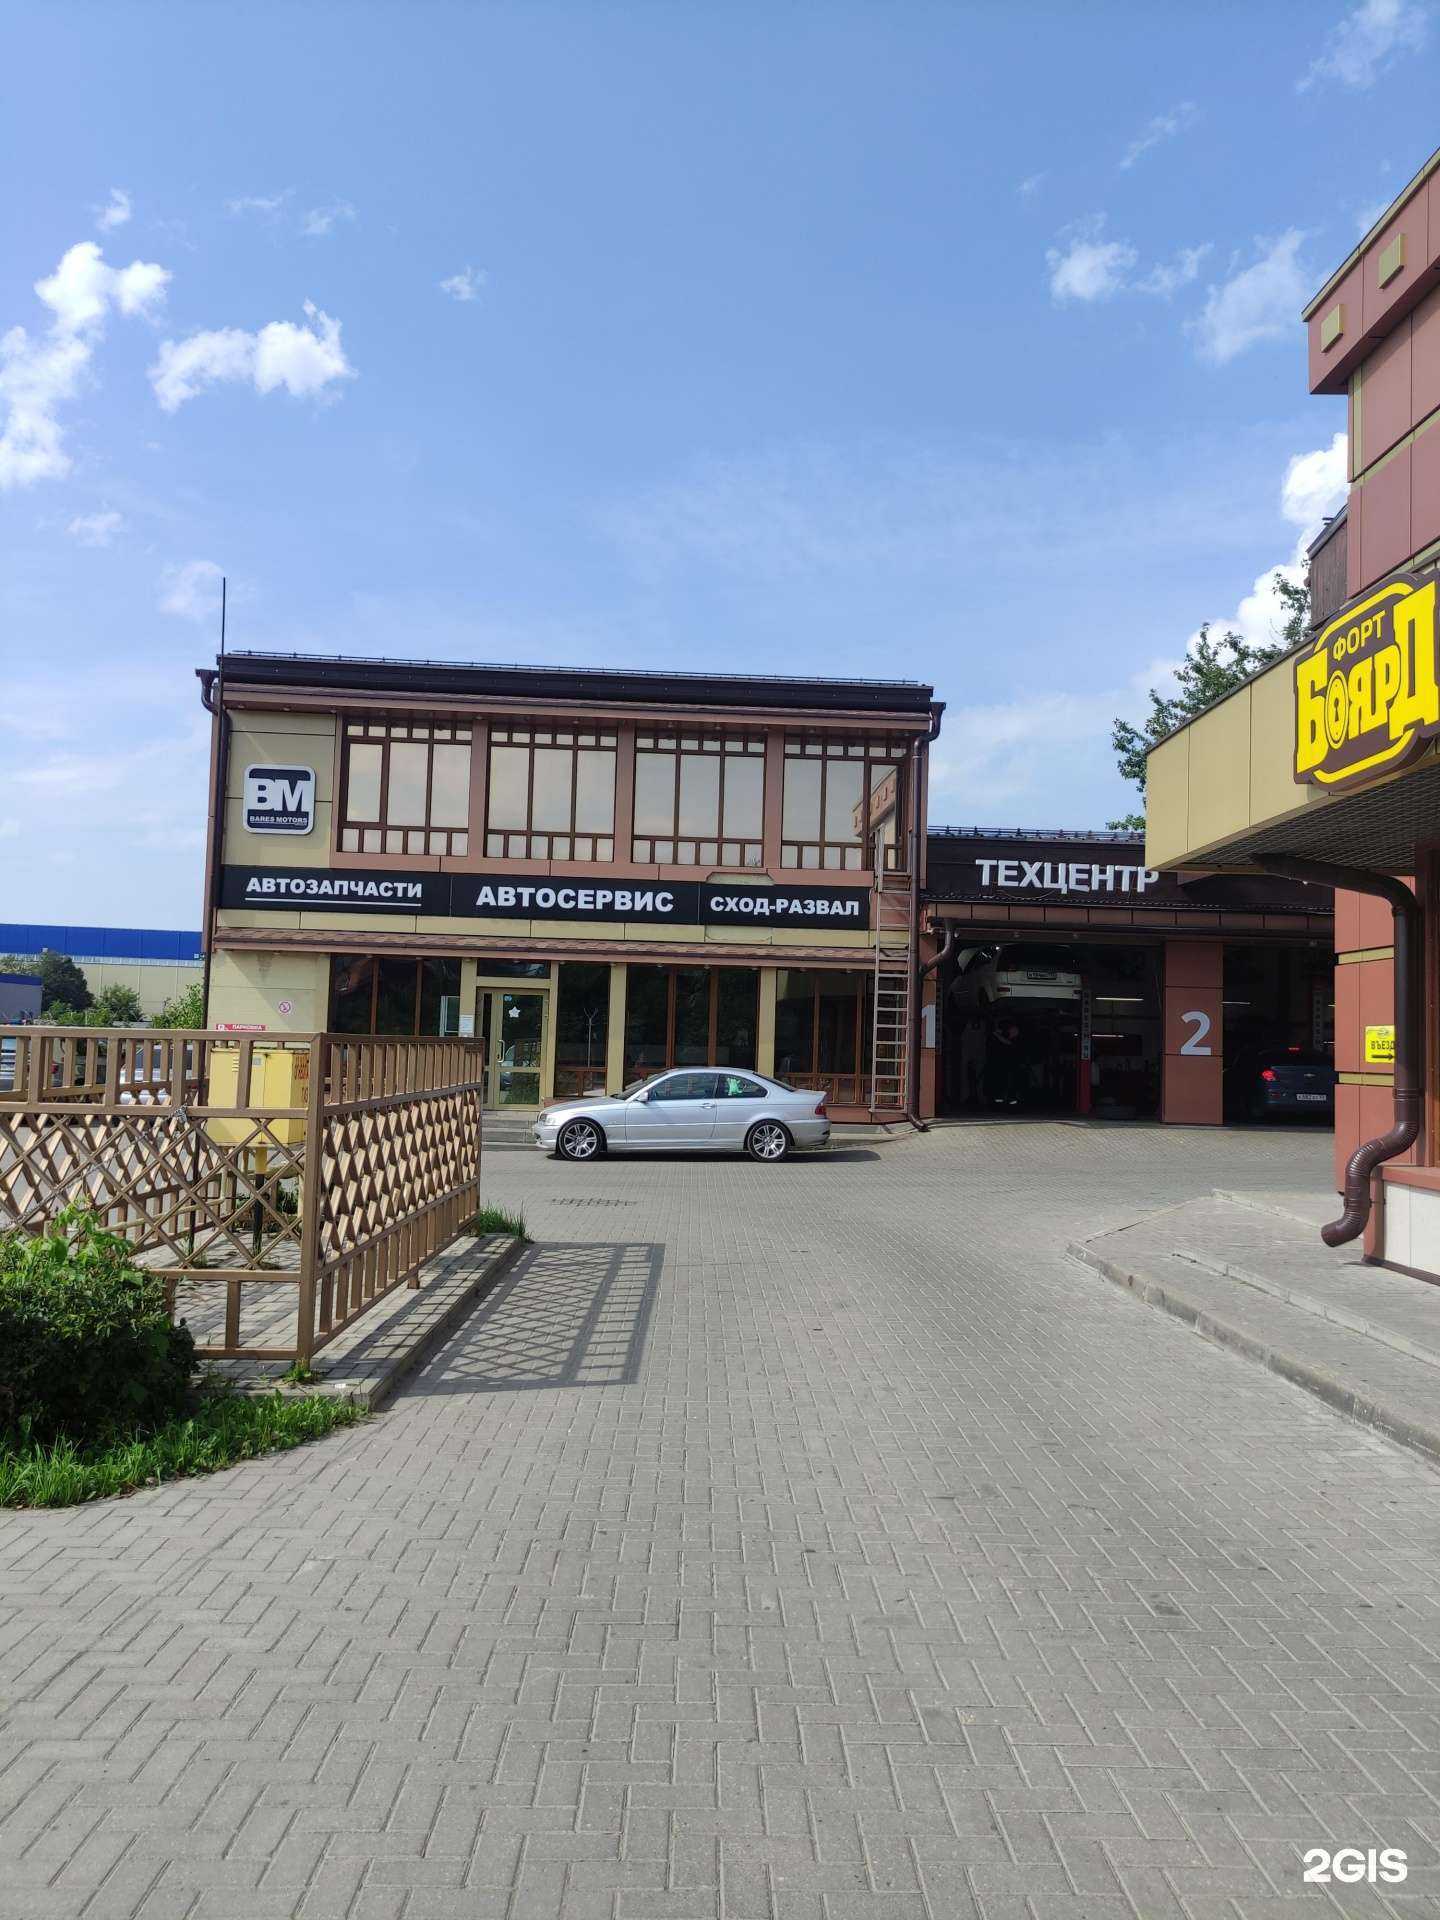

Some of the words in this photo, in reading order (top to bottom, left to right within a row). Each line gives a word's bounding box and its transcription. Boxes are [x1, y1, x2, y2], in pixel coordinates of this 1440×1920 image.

[1333, 610, 1386, 661] ФОРТ
[247, 778, 311, 812] BM
[276, 816, 308, 824] MOTORS
[246, 877, 423, 898] АВТОЗАПЧАСТИ
[975, 859, 1160, 895] ТЕХЦЕНТР
[476, 885, 675, 912] АВТОСЕРВИС
[710, 896, 860, 916] СХОД-РАЗВАЛ
[921, 1004, 936, 1049] 1
[1180, 1011, 1212, 1056] 2
